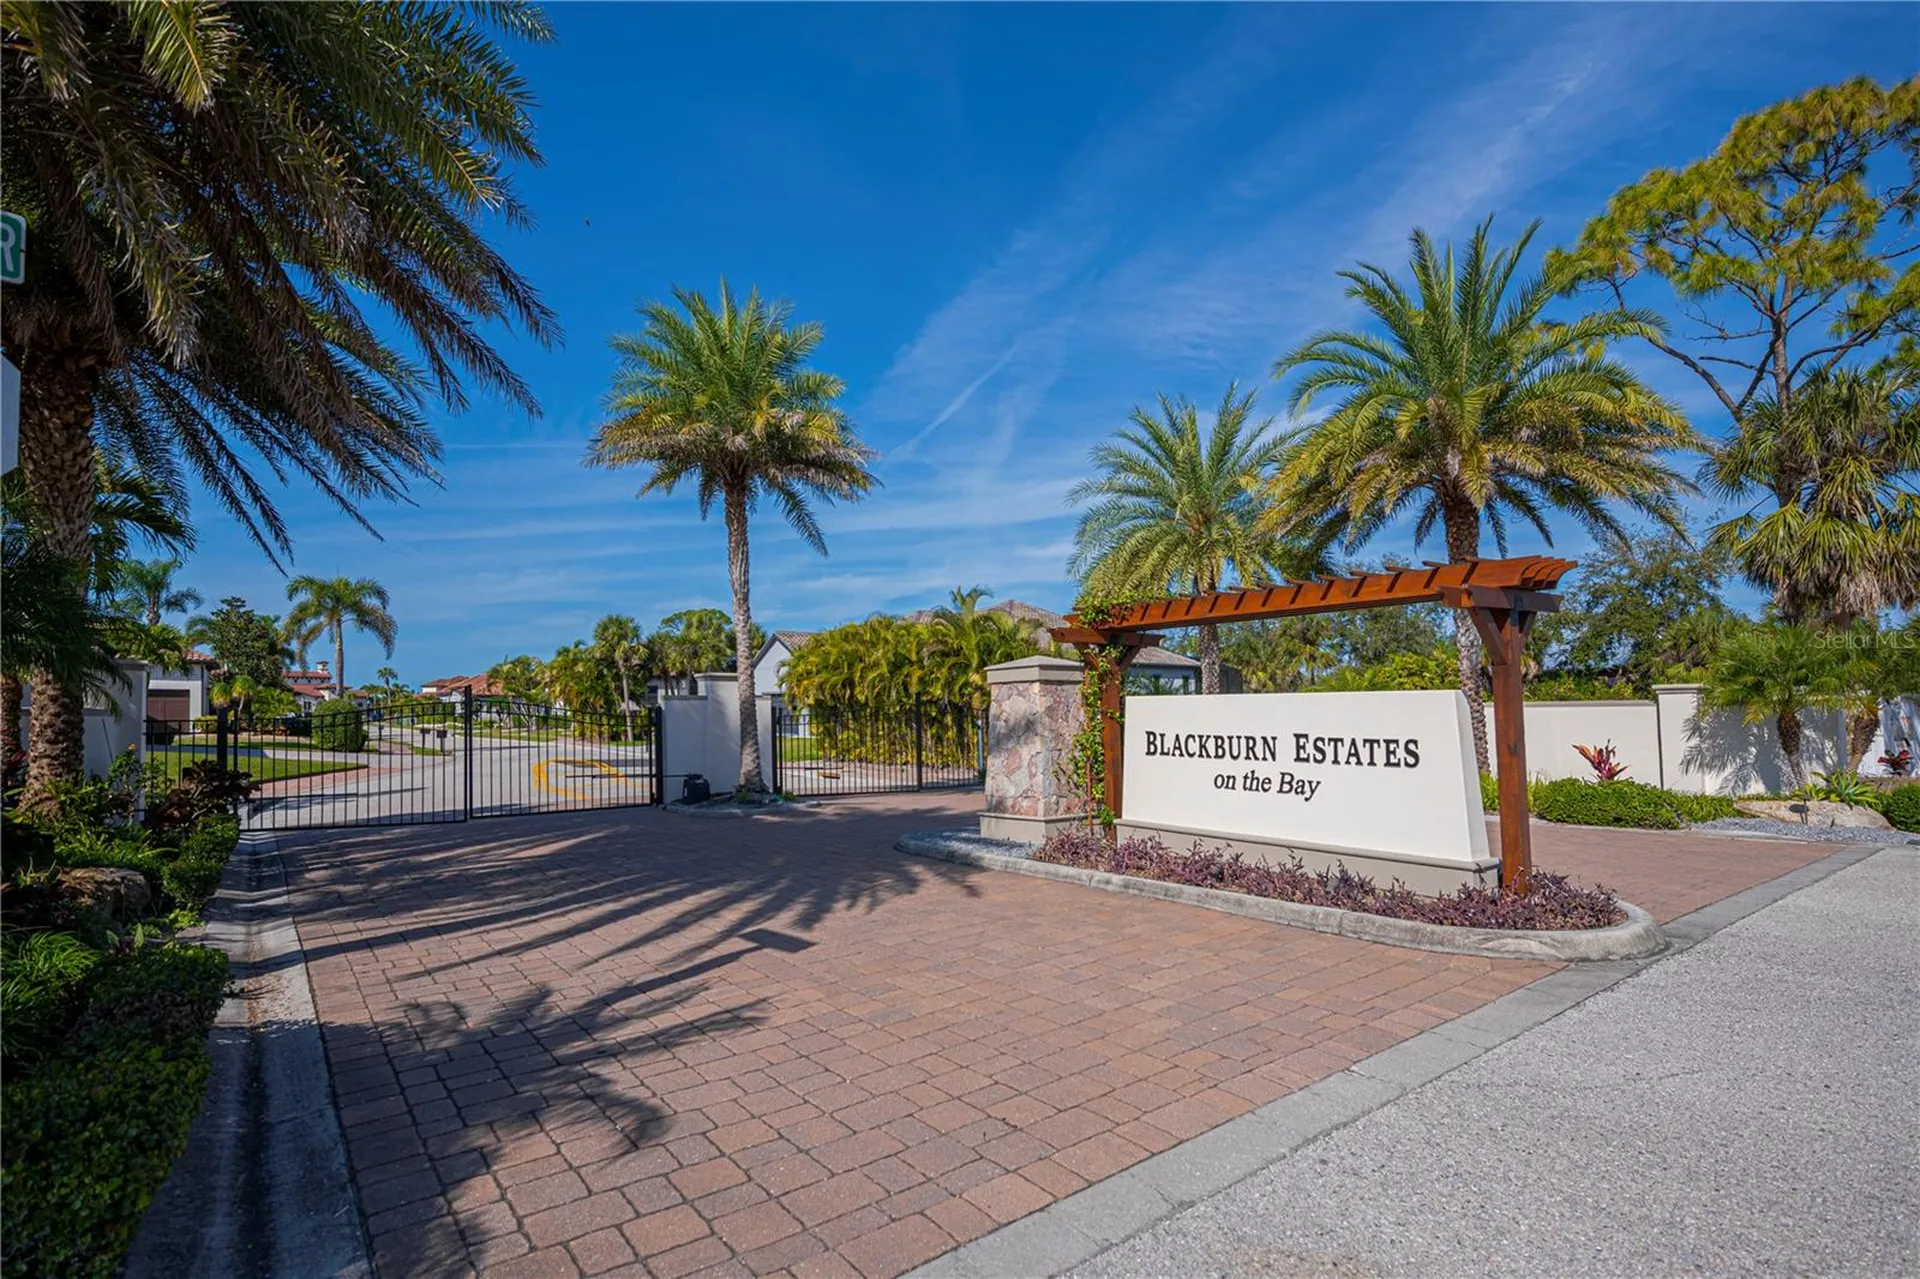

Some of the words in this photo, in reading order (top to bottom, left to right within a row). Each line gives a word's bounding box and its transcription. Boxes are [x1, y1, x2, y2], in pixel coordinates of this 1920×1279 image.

[1145, 731, 1278, 762] BLACKBURN
[1293, 733, 1420, 769] ESTATES
[1213, 773, 1237, 790] on
[1242, 770, 1272, 793] the
[1277, 773, 1322, 802] Bay
